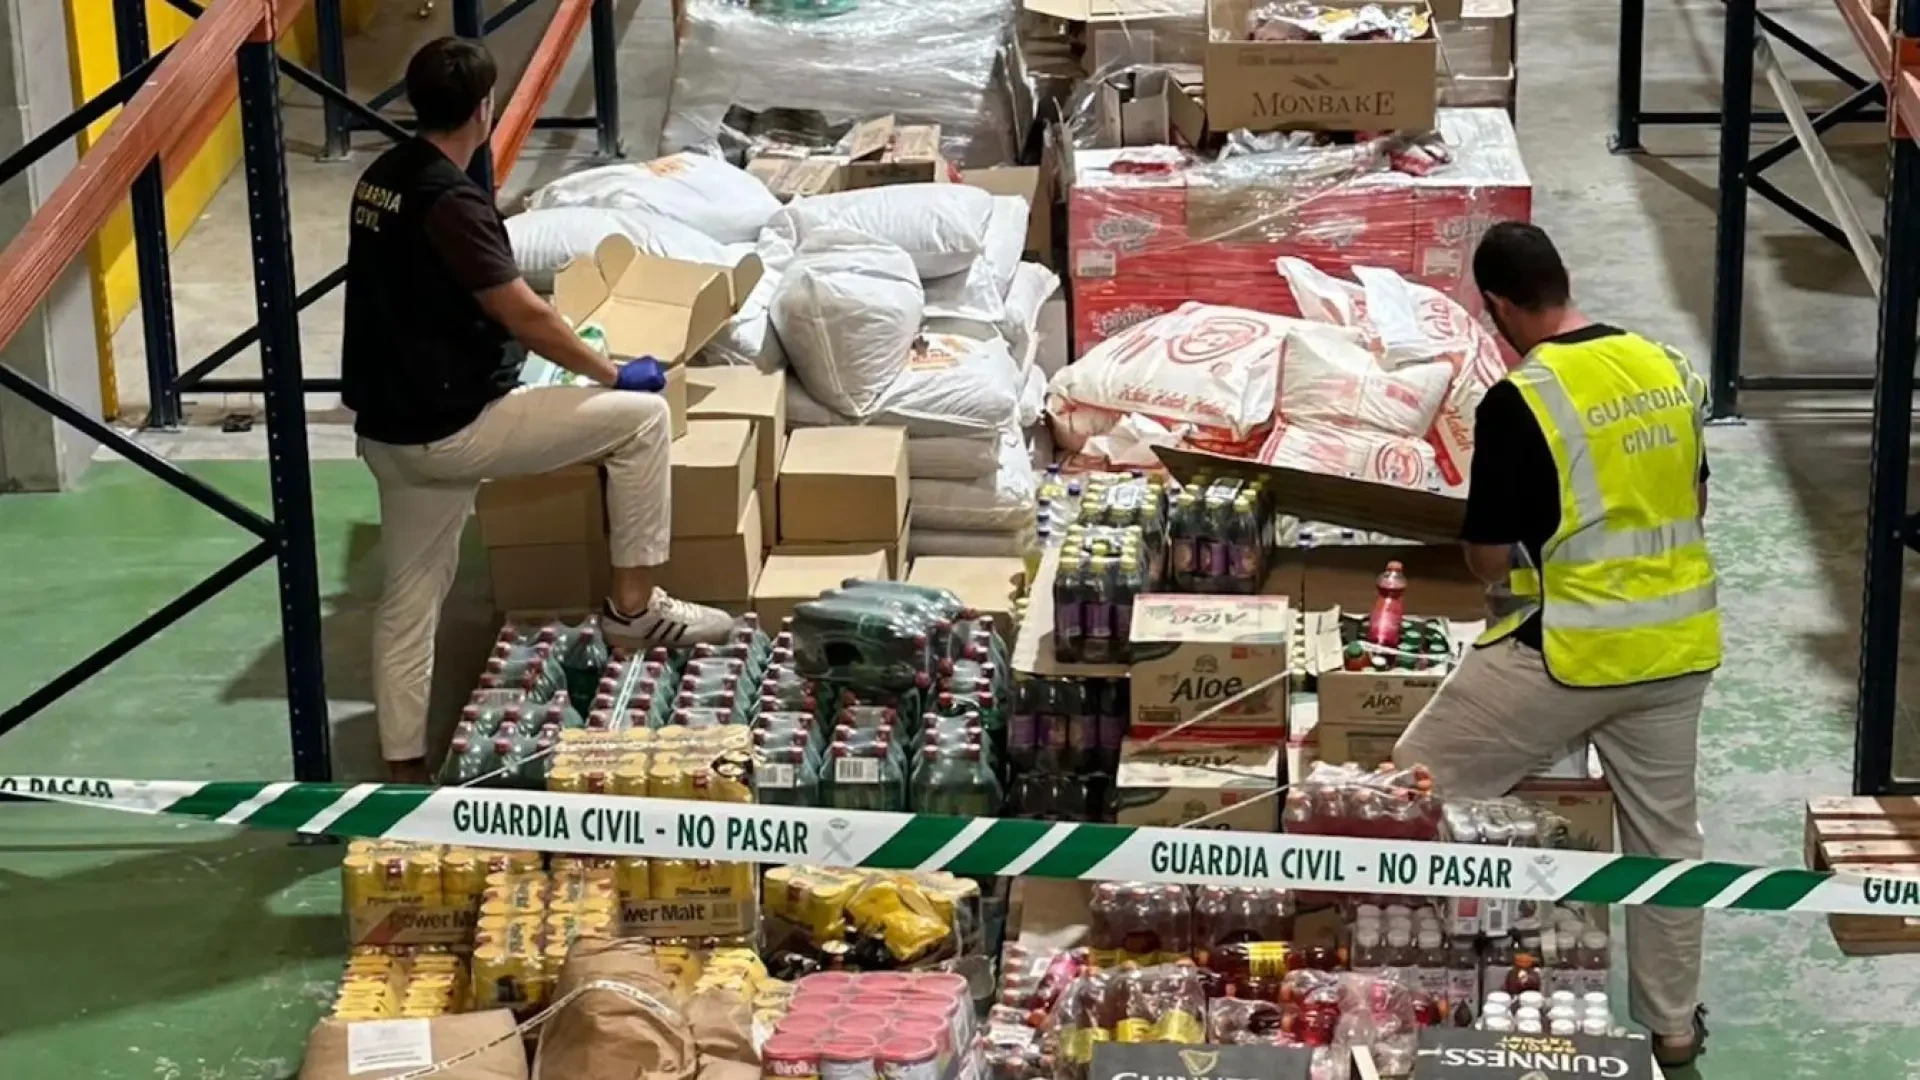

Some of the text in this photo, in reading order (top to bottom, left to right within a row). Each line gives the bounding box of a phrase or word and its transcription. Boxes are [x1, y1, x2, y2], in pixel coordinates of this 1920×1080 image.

[1252, 91, 1396, 118] MONBAKE
[357, 182, 402, 214] GUARDIA
[1587, 386, 1688, 426] GUARDIA
[1622, 423, 1679, 455] CIVIL
[1169, 676, 1245, 704] Aloe
[453, 799, 570, 840] GUARDIA
[581, 807, 645, 844] CIVIL
[677, 813, 715, 849] NO
[726, 816, 809, 855] PASAR
[1151, 840, 1269, 878] GUARDIA
[1281, 847, 1345, 882] CIVIL
[1378, 852, 1417, 885] NO
[1428, 854, 1512, 889] PASAR
[1863, 877, 1919, 904] GUA
[622, 903, 706, 923] wer Malt
[1442, 1048, 1630, 1078] GUINNESS
